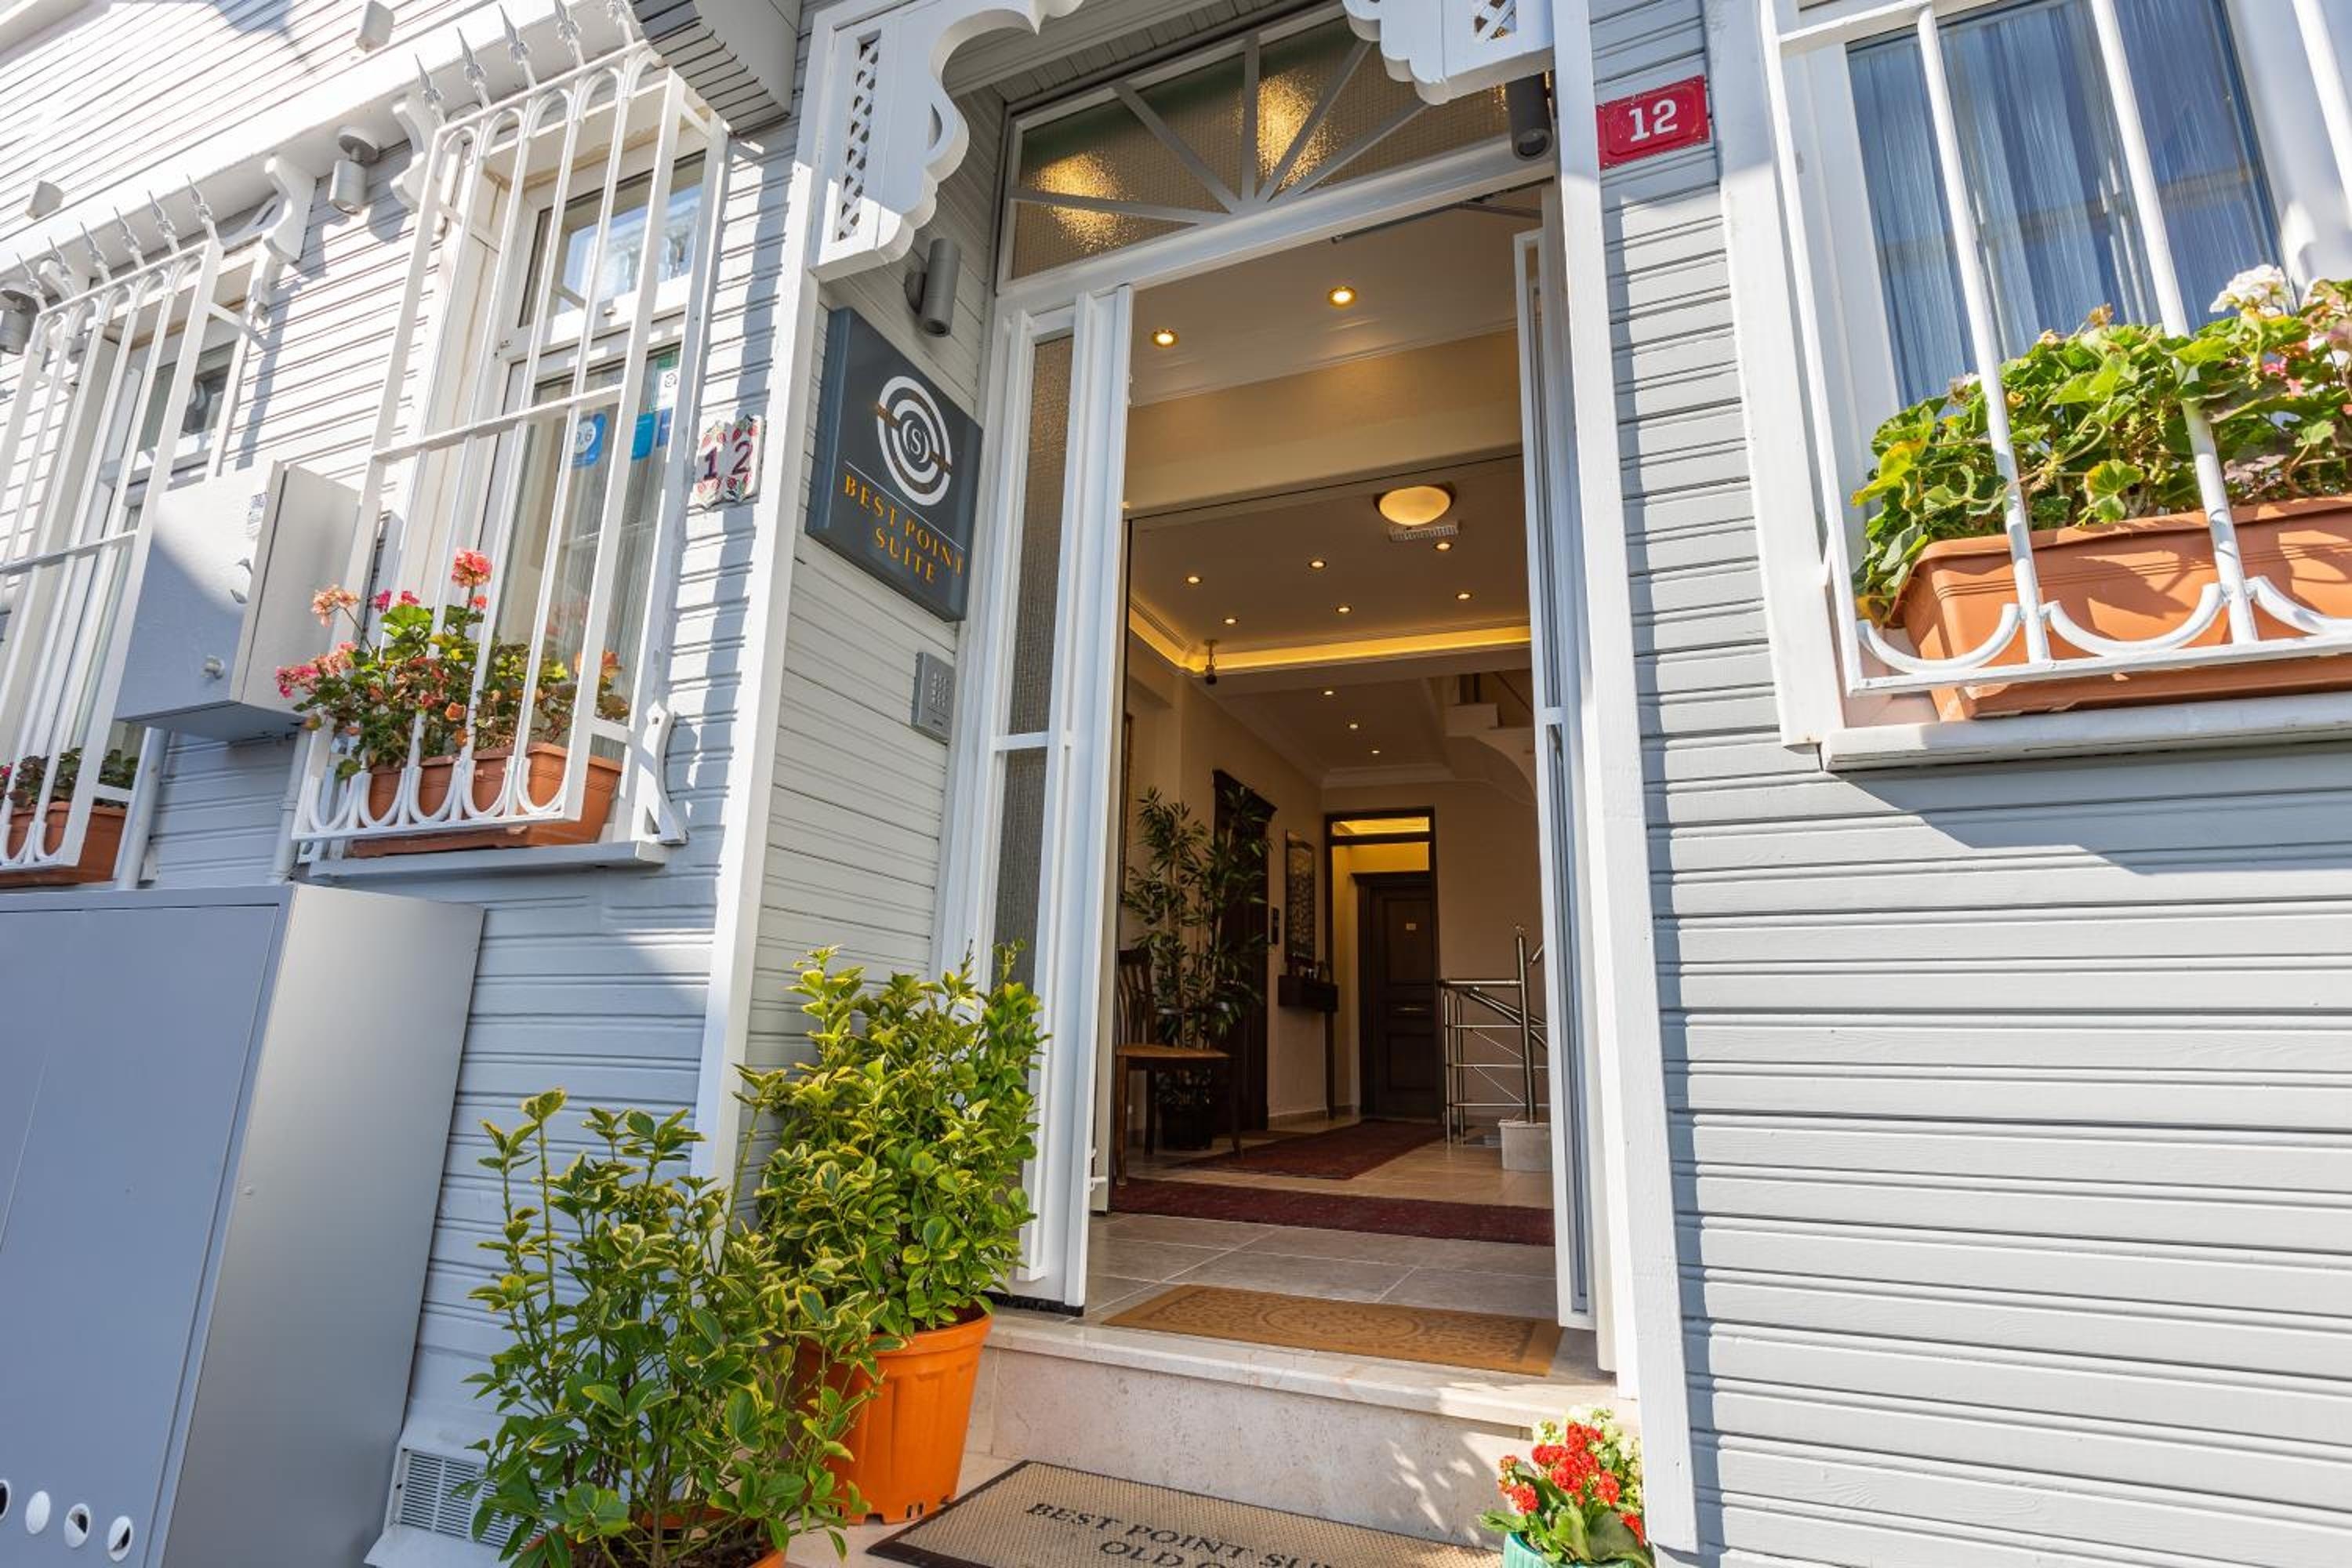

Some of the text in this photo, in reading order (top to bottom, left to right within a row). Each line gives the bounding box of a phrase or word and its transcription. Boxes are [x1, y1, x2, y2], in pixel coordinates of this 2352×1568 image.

[1628, 99, 1678, 142] 12
[702, 441, 753, 480] 12
[844, 475, 964, 575] BEST POINT
[875, 528, 935, 583] SUITE
[1026, 1502, 1123, 1530] BEST
[1126, 1524, 1254, 1559] POINT
[1100, 1541, 1185, 1566] OLD
